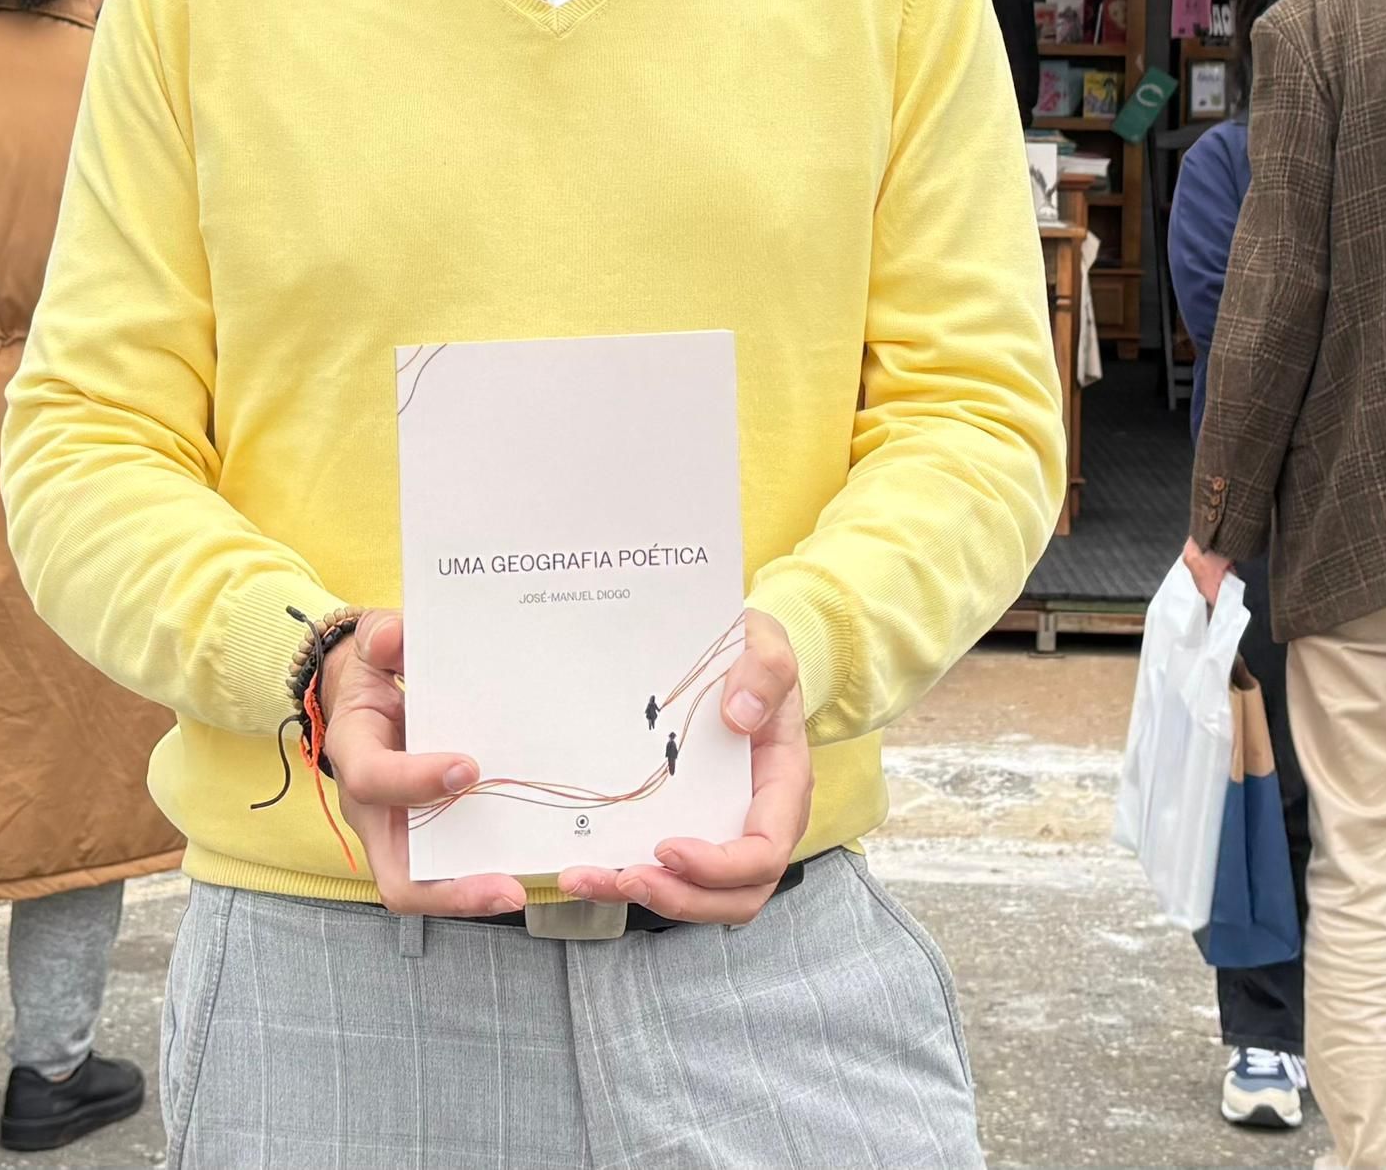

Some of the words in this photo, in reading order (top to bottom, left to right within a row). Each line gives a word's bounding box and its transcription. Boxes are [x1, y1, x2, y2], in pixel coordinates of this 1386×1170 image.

[438, 556, 486, 576] UMA
[490, 550, 614, 574] GEOGRAFIA
[618, 542, 710, 569] POÉTICA
[596, 588, 631, 602] DIOGO
